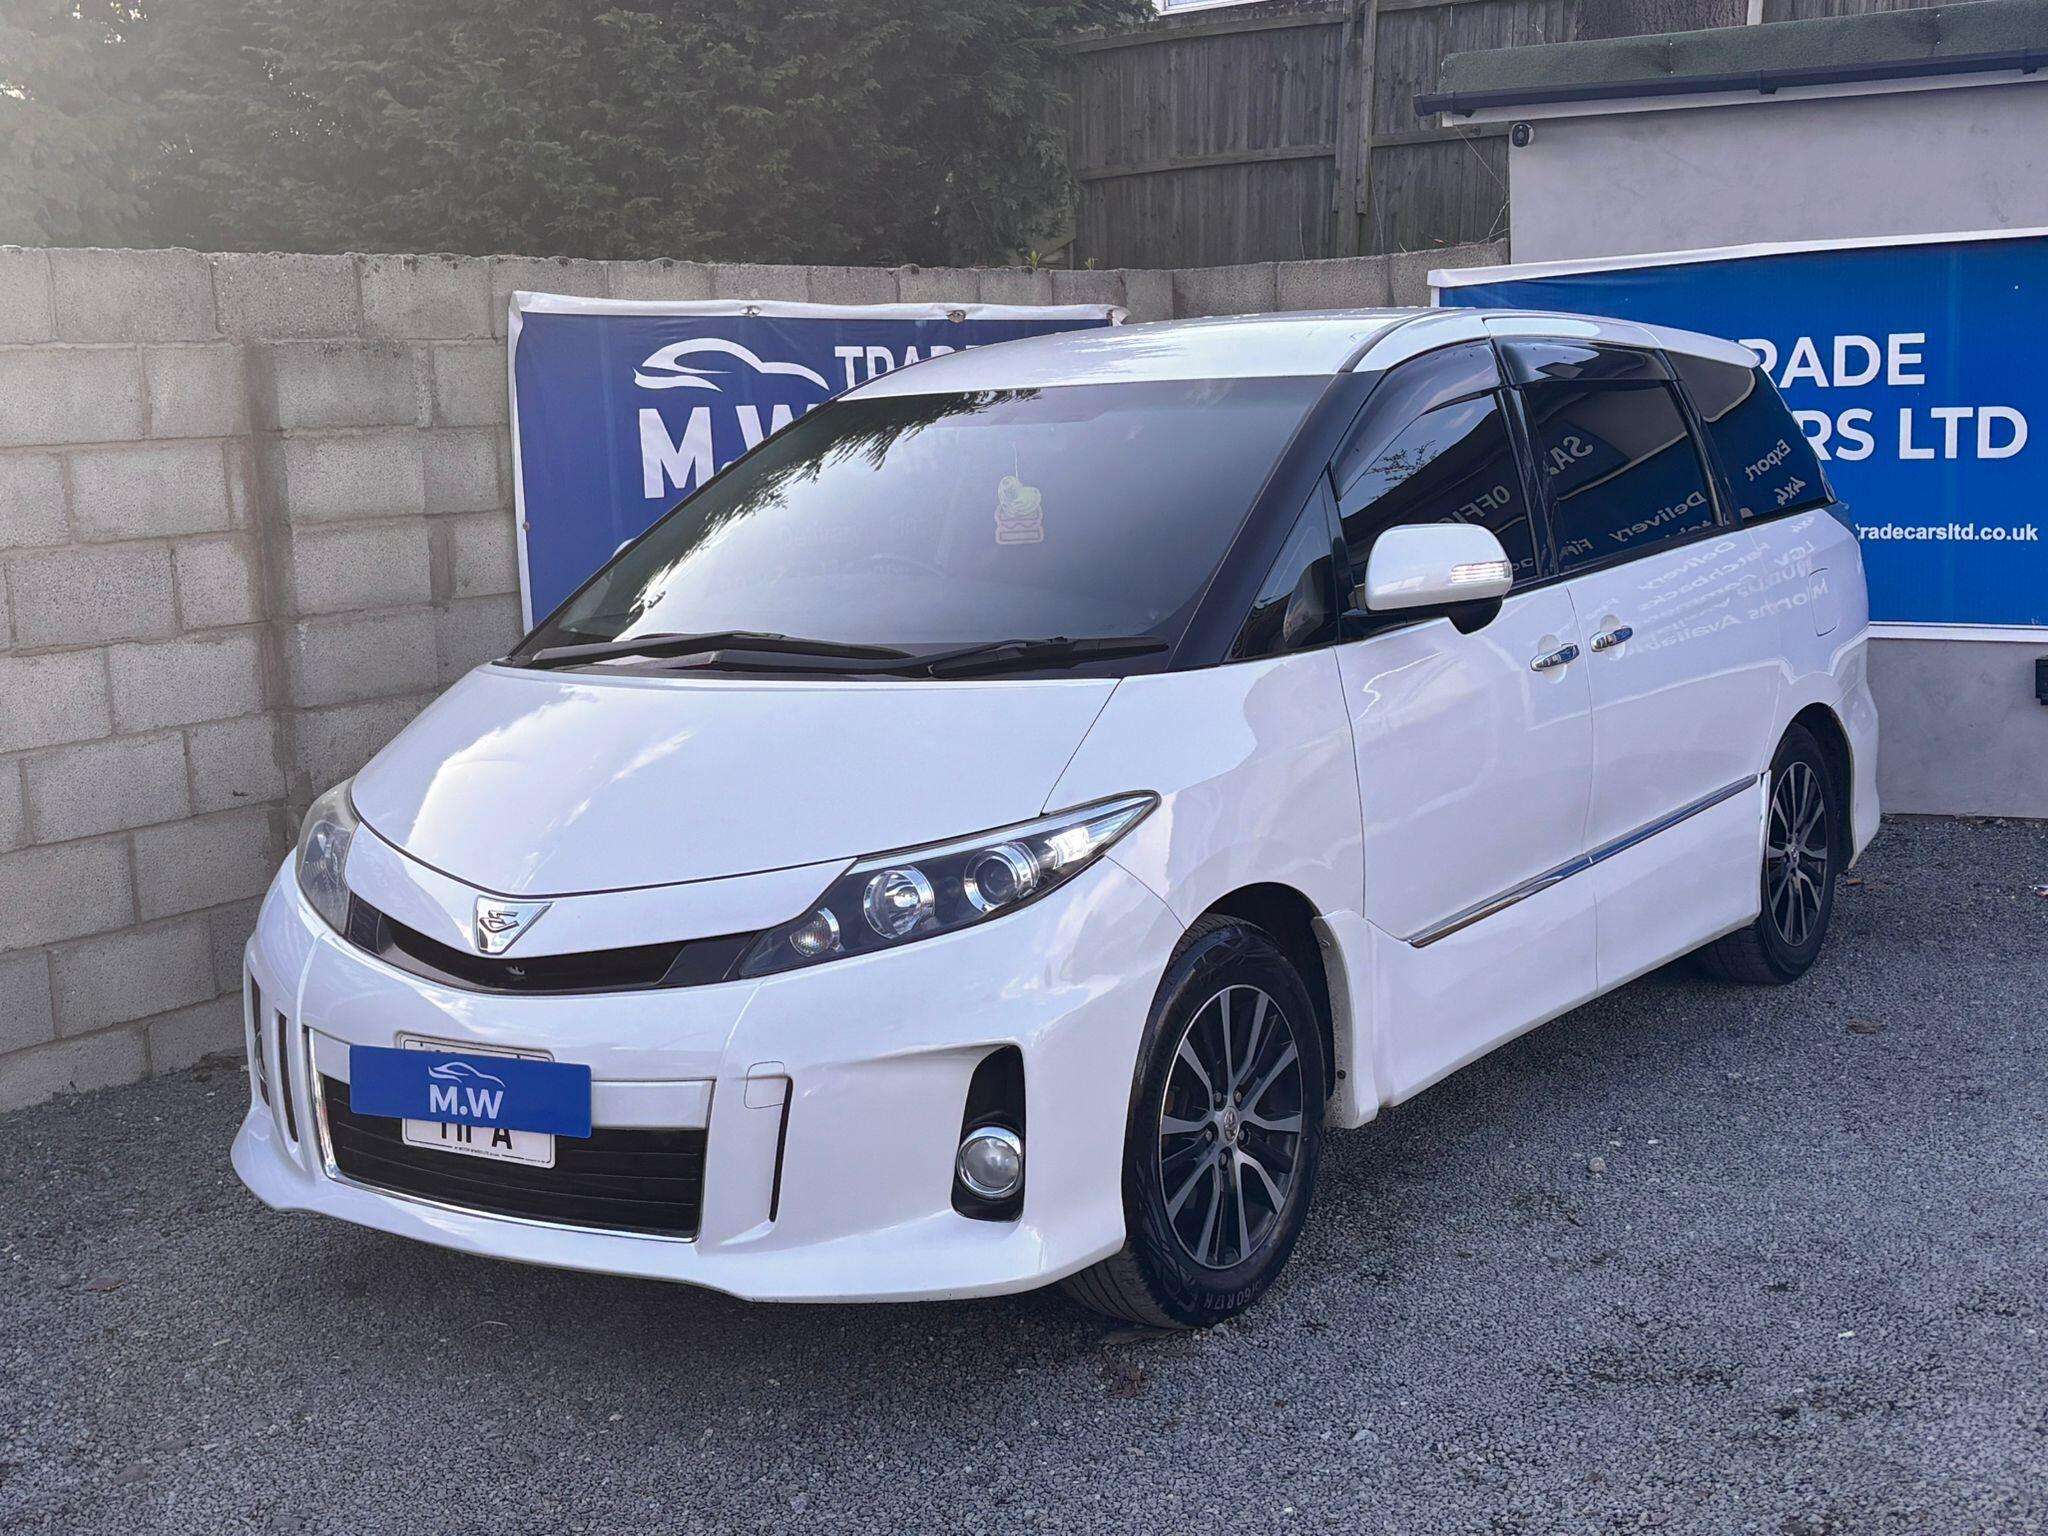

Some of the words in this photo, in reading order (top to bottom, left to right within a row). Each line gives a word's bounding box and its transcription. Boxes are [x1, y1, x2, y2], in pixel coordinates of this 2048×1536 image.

[1739, 332, 1925, 388] RADE
[1792, 408, 1875, 461] RS
[1899, 405, 2028, 460] LTD
[1855, 523, 2039, 541] radecarsltd.co.uk
[429, 1084, 504, 1119] M.W
